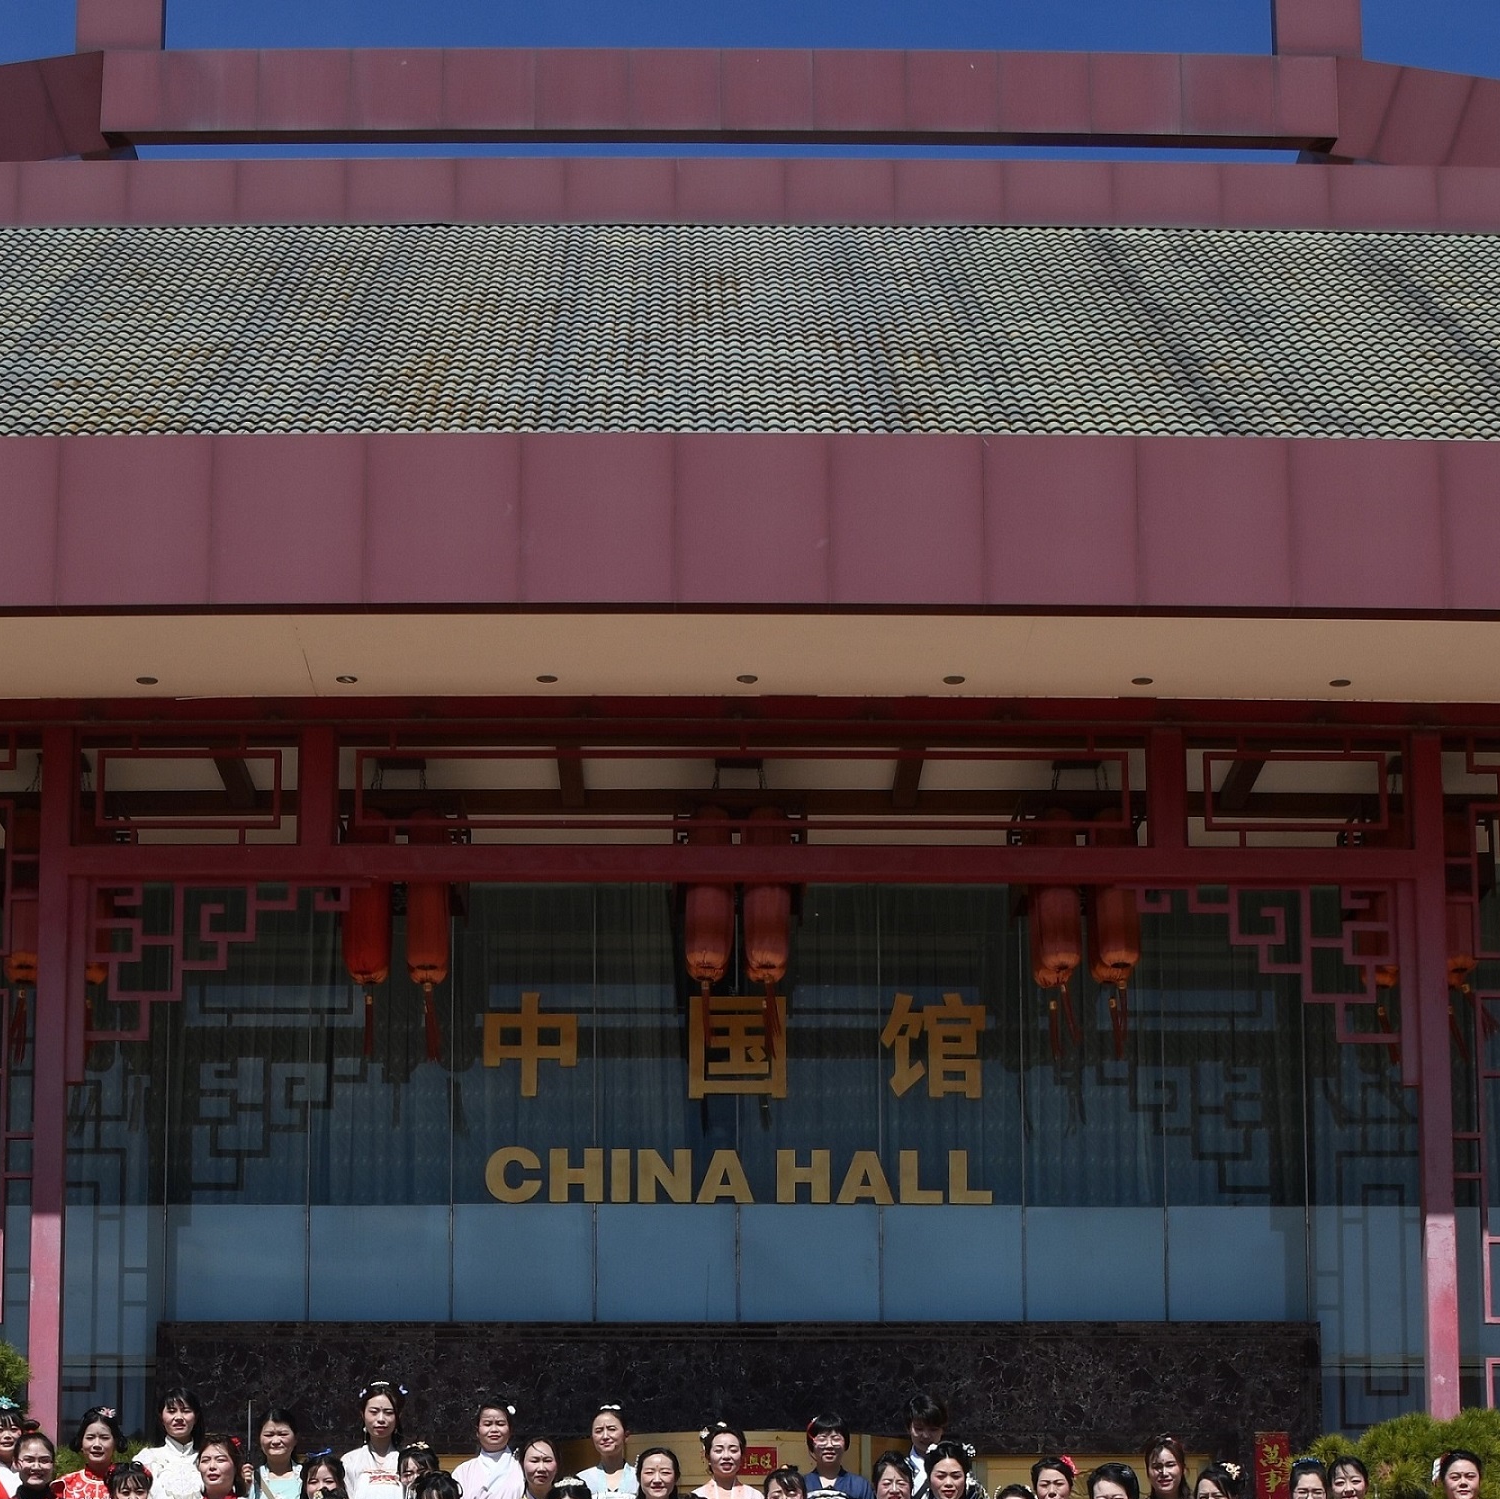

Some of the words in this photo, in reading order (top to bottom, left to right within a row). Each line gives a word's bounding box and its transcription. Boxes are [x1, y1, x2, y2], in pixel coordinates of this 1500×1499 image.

[482, 991, 987, 1099] 中国馆
[484, 1146, 754, 1205] CHINA
[776, 1148, 993, 1206] HALL
